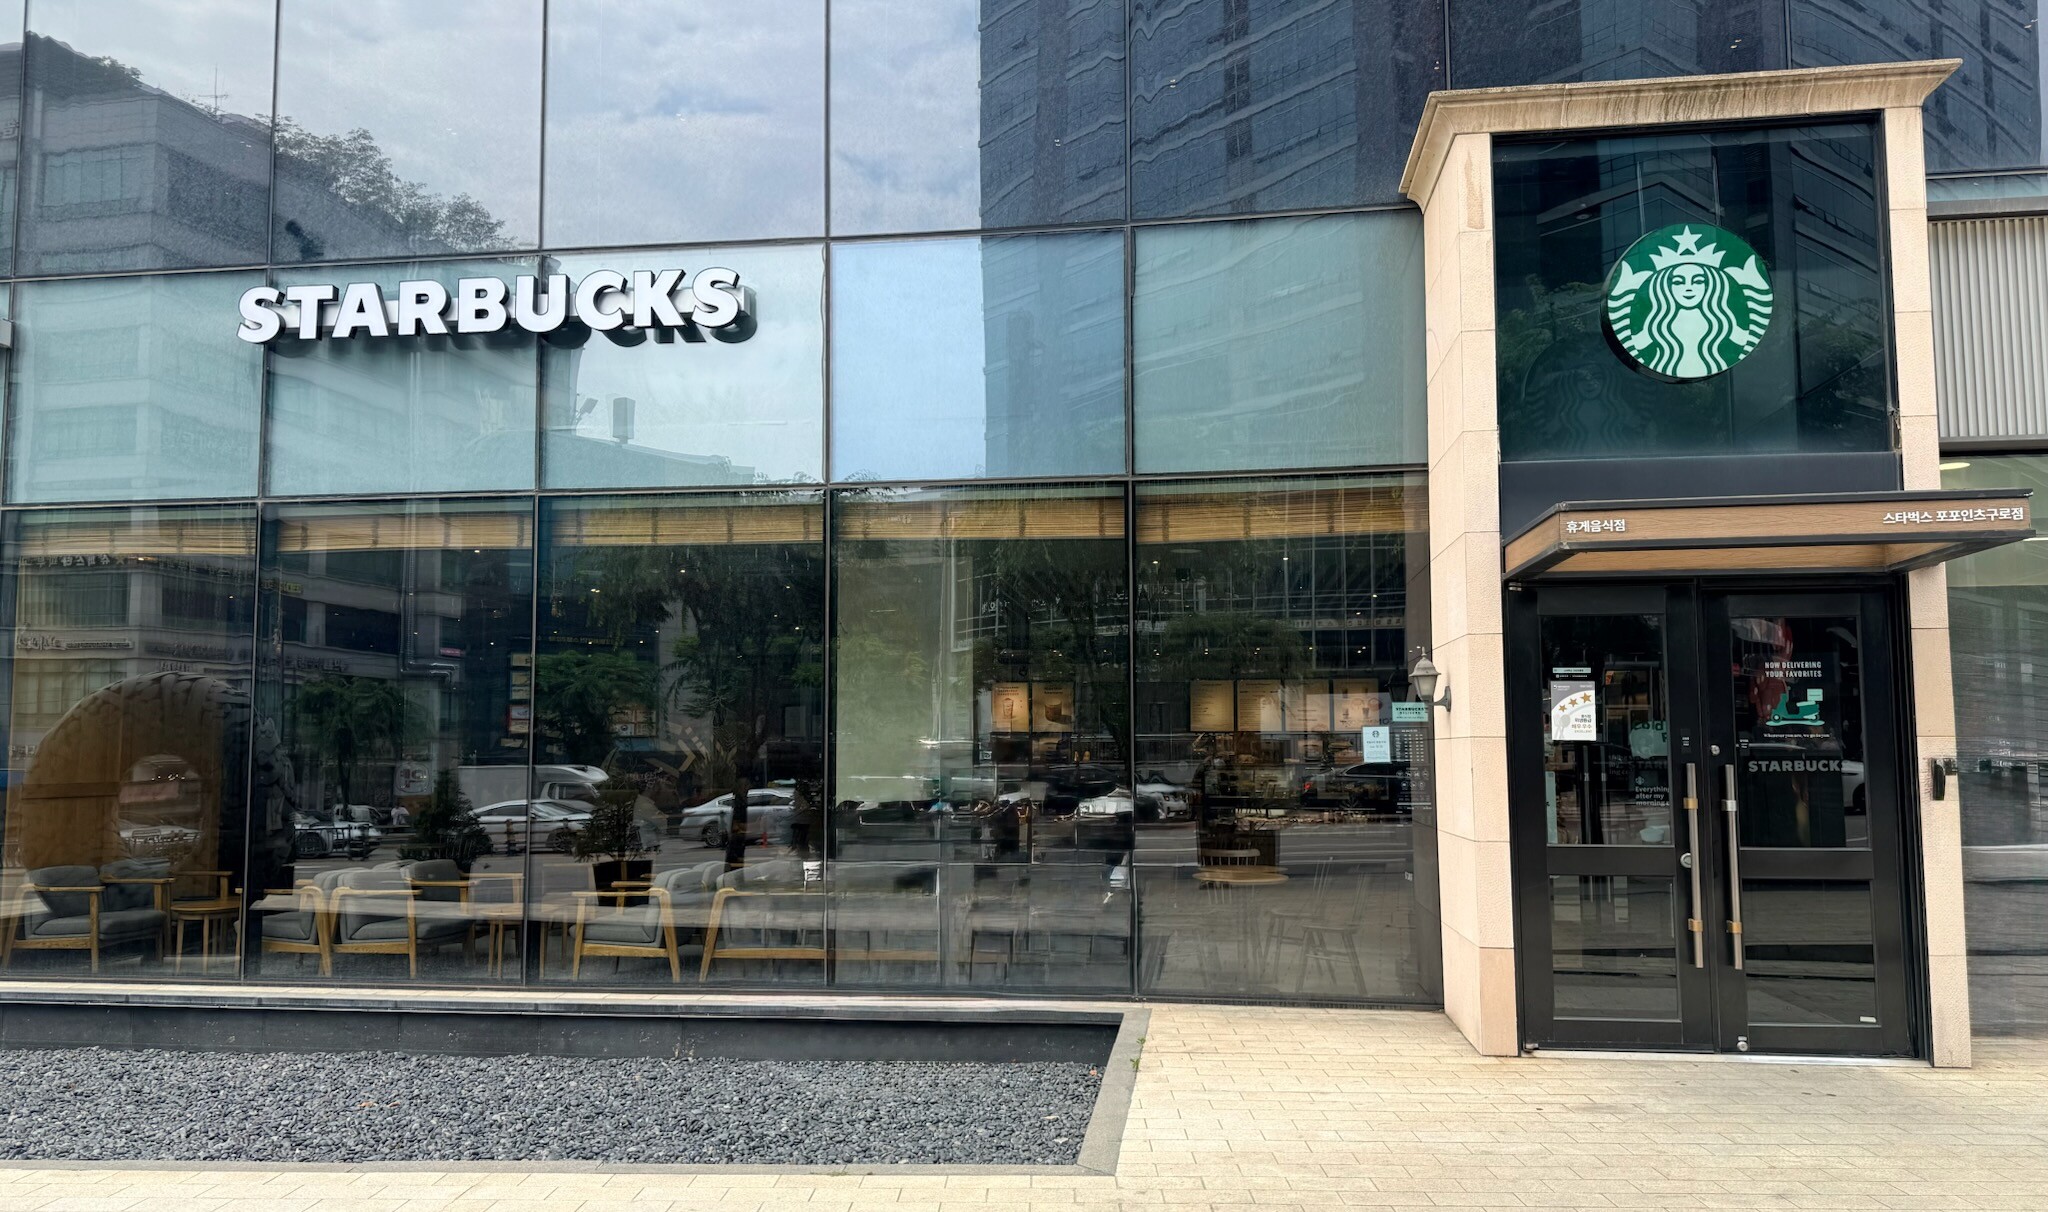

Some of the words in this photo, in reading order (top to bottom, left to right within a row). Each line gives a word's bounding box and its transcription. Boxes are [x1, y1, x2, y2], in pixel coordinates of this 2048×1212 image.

[237, 267, 742, 344] STARBUCKS
[1882, 511, 1933, 525] 스타벅스
[1935, 507, 2024, 522] 포포인츠구로점
[1566, 519, 1626, 534] 휴게음식점
[1764, 661, 1781, 669] NOW
[1781, 661, 1822, 669] DELIVERING
[1765, 670, 1784, 678] YOUR
[1785, 670, 1822, 678] FAVORITES
[1748, 760, 1849, 772] STARBUCK
